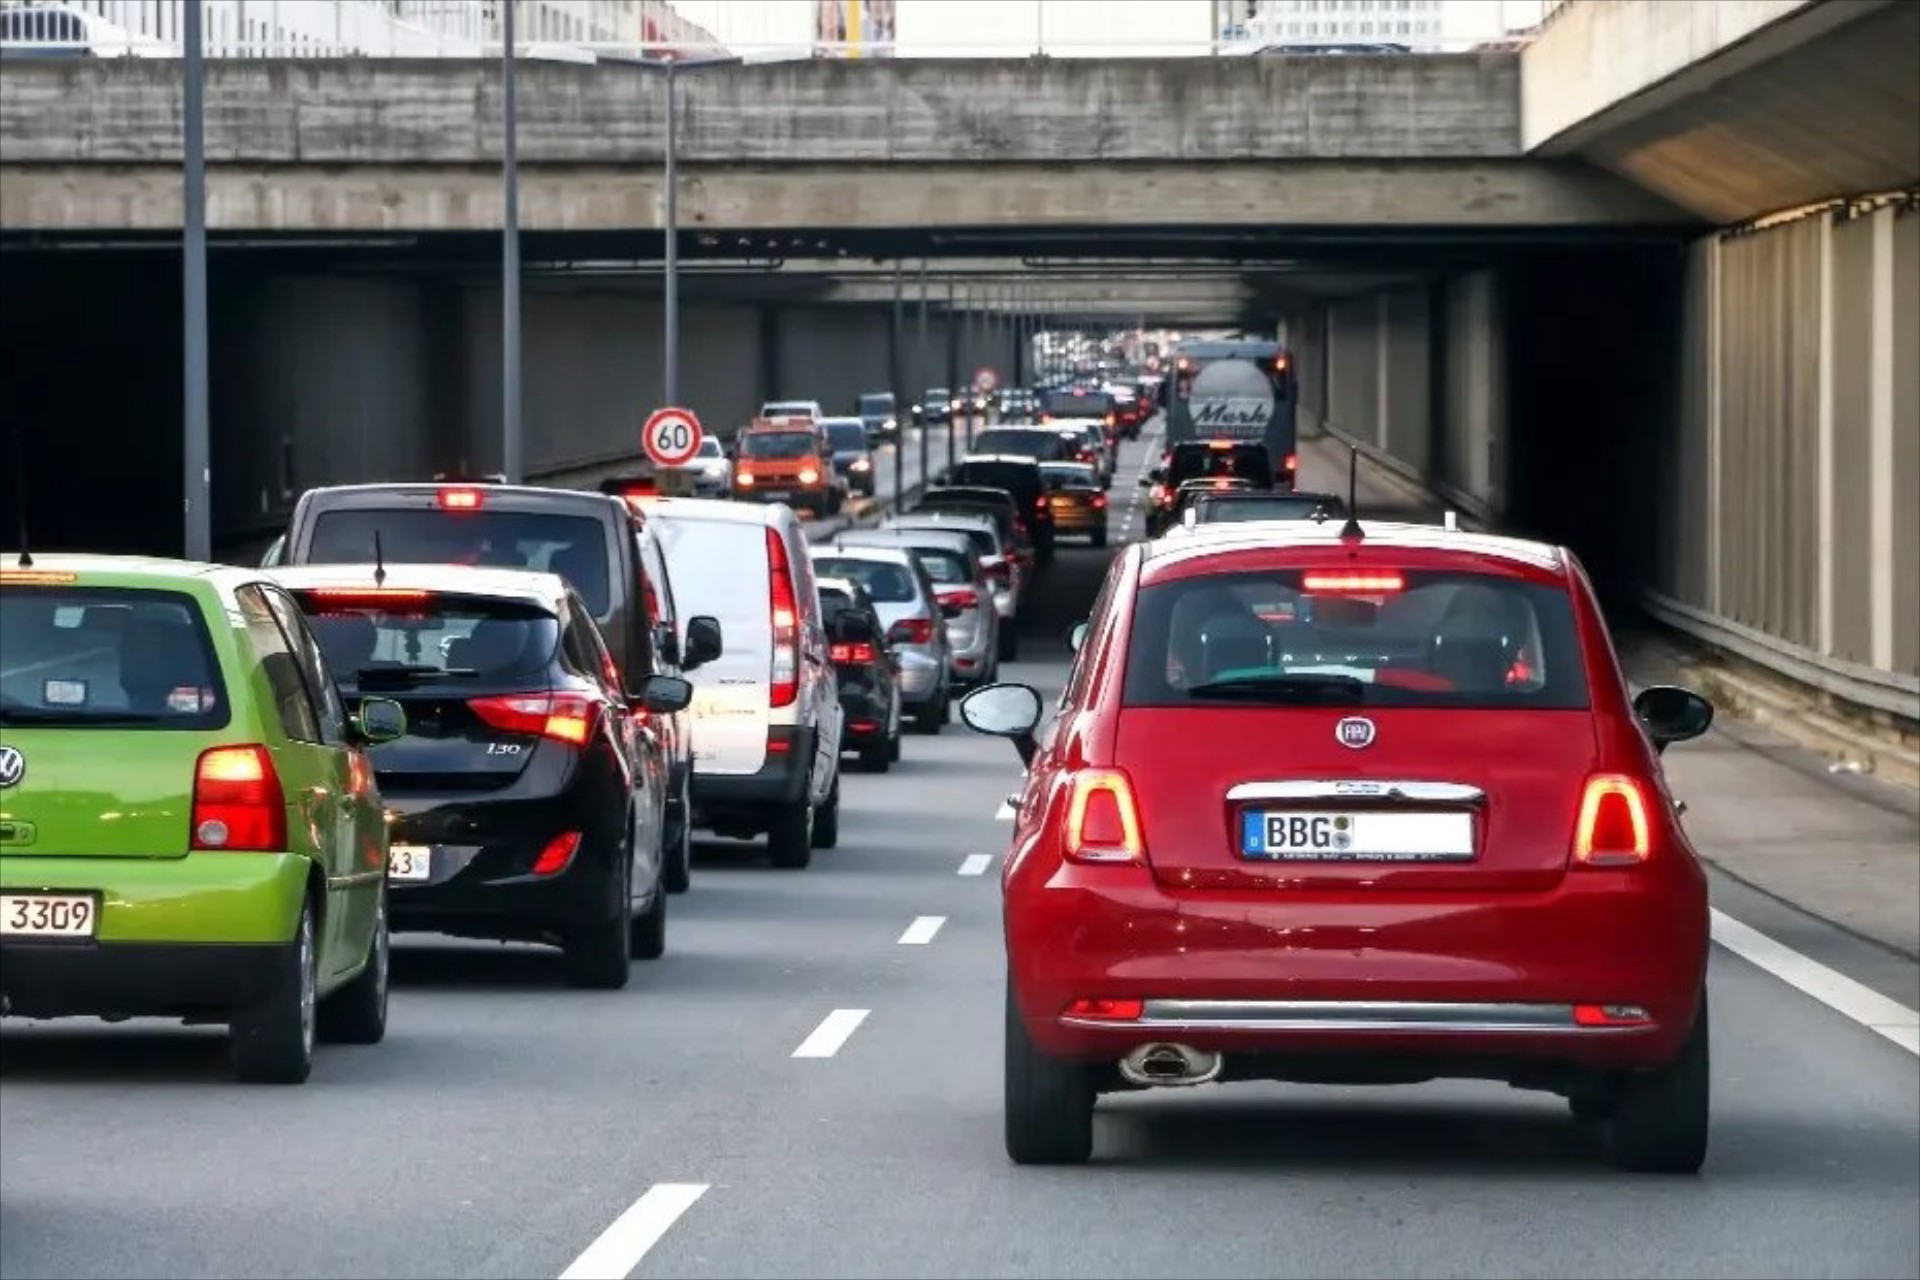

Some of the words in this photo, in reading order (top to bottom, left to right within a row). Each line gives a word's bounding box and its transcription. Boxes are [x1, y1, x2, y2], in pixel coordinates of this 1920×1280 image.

[658, 425, 688, 450] 60
[1267, 816, 1330, 848] BBG
[10, 899, 90, 931] 3309
